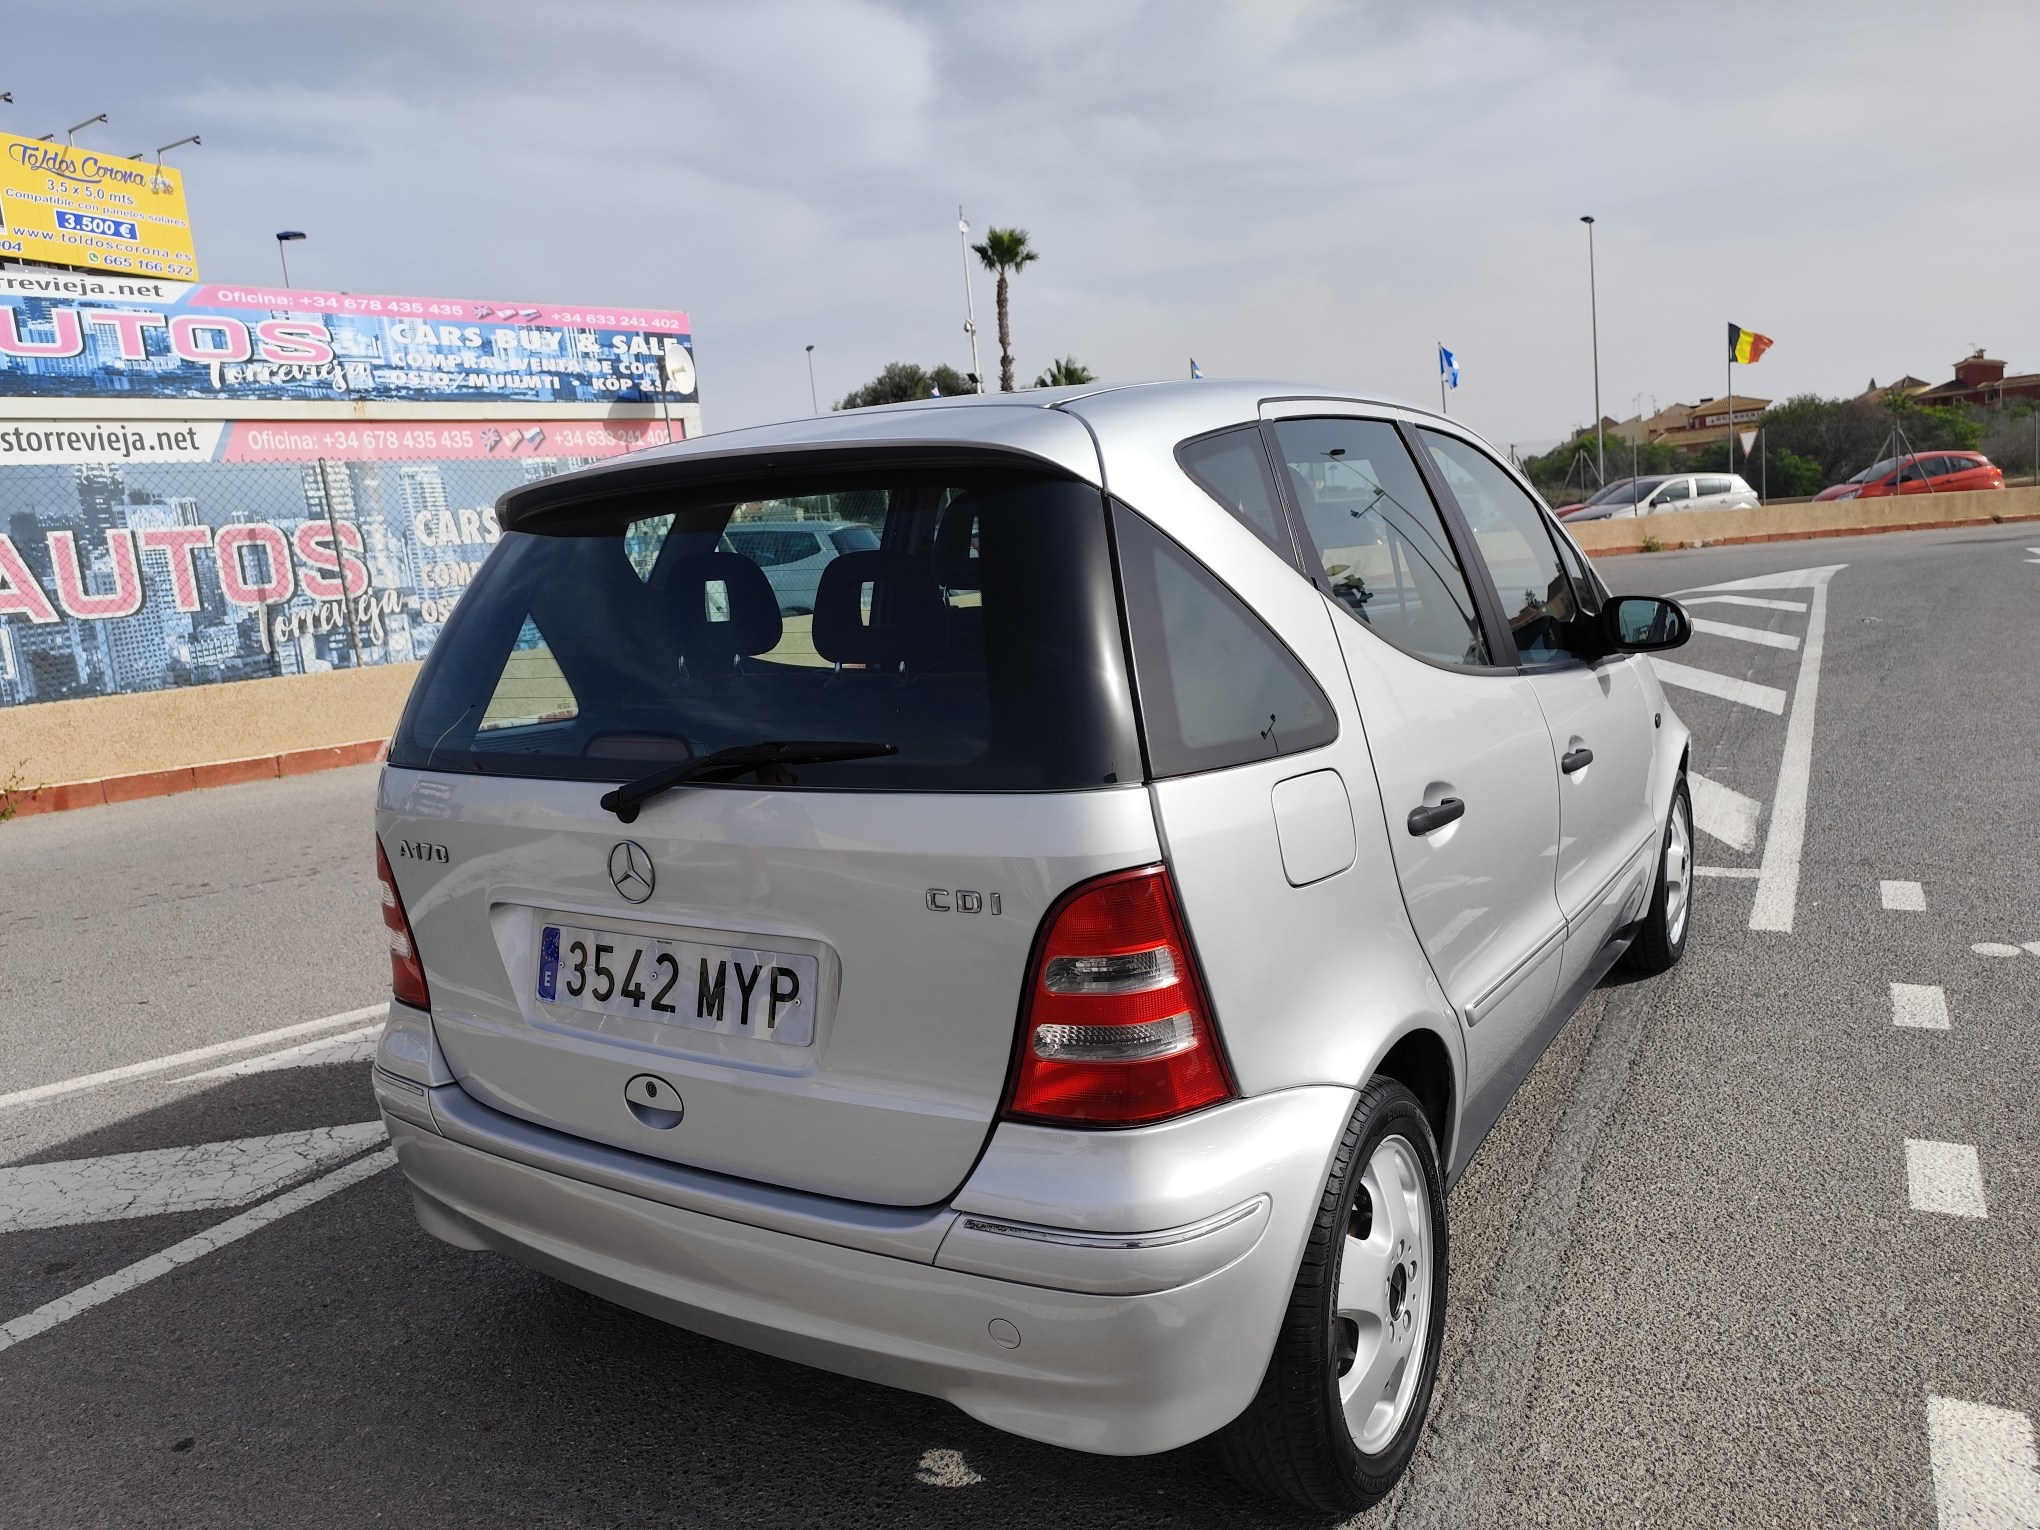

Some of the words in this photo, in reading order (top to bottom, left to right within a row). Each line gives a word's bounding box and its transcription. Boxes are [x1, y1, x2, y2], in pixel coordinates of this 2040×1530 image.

[9, 143, 80, 176] Toldos
[82, 156, 147, 188] Corona
[47, 179, 68, 193] 3,5
[85, 182, 105, 200] 5,0
[5, 188, 74, 207] Compatible
[78, 200, 99, 211] con
[103, 204, 145, 219] paneles
[148, 214, 186, 227] solares
[64, 213, 115, 235] 3.500
[0, 240, 23, 252] 04
[13, 227, 192, 261] www.toldoscorona.es
[104, 255, 132, 268] 665
[138, 260, 163, 272] 166
[168, 264, 193, 276] 572
[218, 290, 294, 307] Oficina:
[299, 296, 338, 309] +34
[344, 298, 382, 311] 678
[388, 301, 423, 313] 435
[428, 302, 464, 316] 435
[551, 312, 582, 323] +34
[586, 314, 617, 325] 633
[620, 316, 649, 328] 241
[652, 318, 680, 329] 402
[391, 322, 483, 348] CARS
[495, 328, 562, 351] BUY
[579, 333, 600, 353] &
[394, 352, 495, 369] COMPRA
[588, 360, 613, 374] DE
[209, 359, 370, 393] Torrevieja
[592, 375, 633, 391] KÖP
[0, 425, 200, 458] storrevieja.net
[248, 430, 319, 450] Oficina:
[323, 431, 360, 449] +34
[363, 430, 399, 449] 678
[403, 430, 437, 449] 435
[441, 430, 474, 449] 435
[554, 430, 583, 447] +34
[586, 429, 615, 446] 633
[618, 429, 645, 446] 241
[414, 507, 501, 547] CARS
[543, 971, 552, 987] E
[566, 941, 679, 1013] 3542
[696, 957, 800, 1029] MYP
